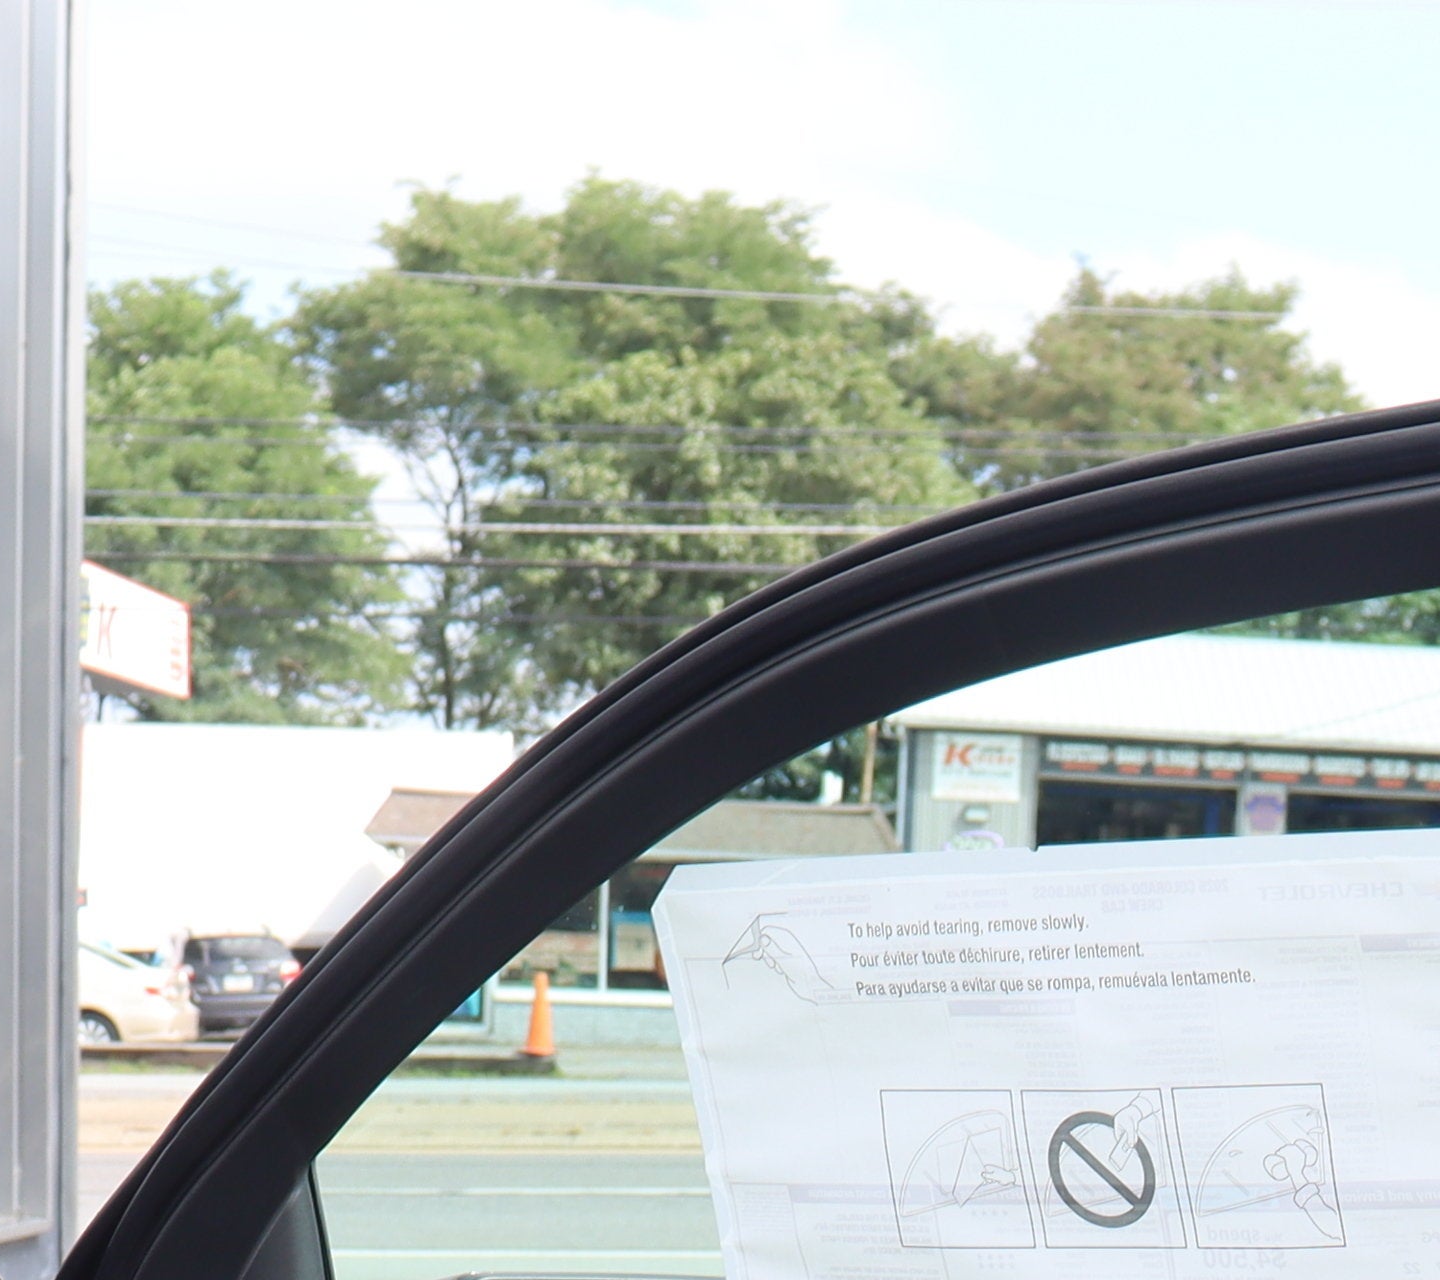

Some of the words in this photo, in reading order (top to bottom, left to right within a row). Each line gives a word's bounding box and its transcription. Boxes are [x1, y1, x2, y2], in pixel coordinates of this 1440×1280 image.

[848, 922, 863, 938] To
[866, 921, 892, 940] help
[896, 920, 930, 937] avoid
[933, 918, 984, 937] tearing,
[987, 918, 1037, 934] remove
[1041, 913, 1089, 932] slowly.
[850, 952, 879, 968] Pour
[883, 949, 919, 967] éviter
[922, 949, 956, 965] toute
[959, 946, 1025, 964] déchirure,
[1028, 945, 1070, 961] retirer
[1074, 941, 1145, 960] lentement.
[855, 980, 887, 997] Para
[888, 979, 947, 998] ayudarse
[950, 981, 960, 993] a
[962, 976, 996, 992] evitar
[999, 980, 1024, 996] que
[1027, 979, 1043, 992] se
[1047, 975, 1095, 993] rompa,
[1098, 971, 1168, 989] remuévala
[1171, 967, 1256, 987] lentamente.
